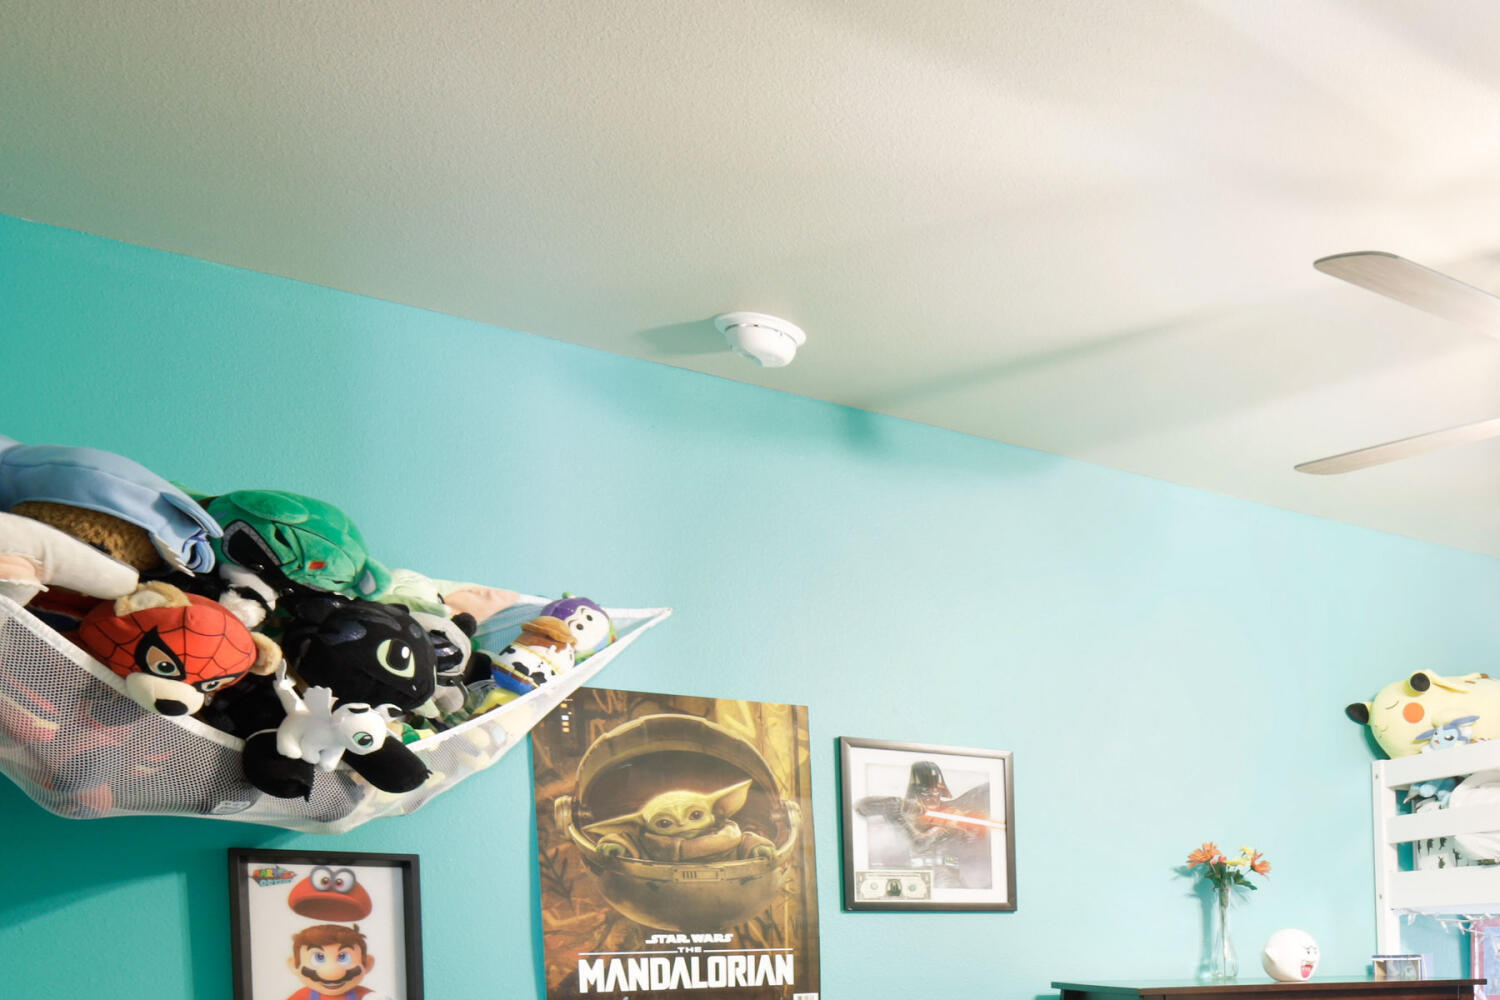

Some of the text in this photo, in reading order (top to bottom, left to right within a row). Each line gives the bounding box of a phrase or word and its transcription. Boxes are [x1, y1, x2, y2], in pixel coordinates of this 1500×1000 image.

[645, 933, 734, 944] STAR WARS
[578, 953, 795, 993] MANDALORIAN
